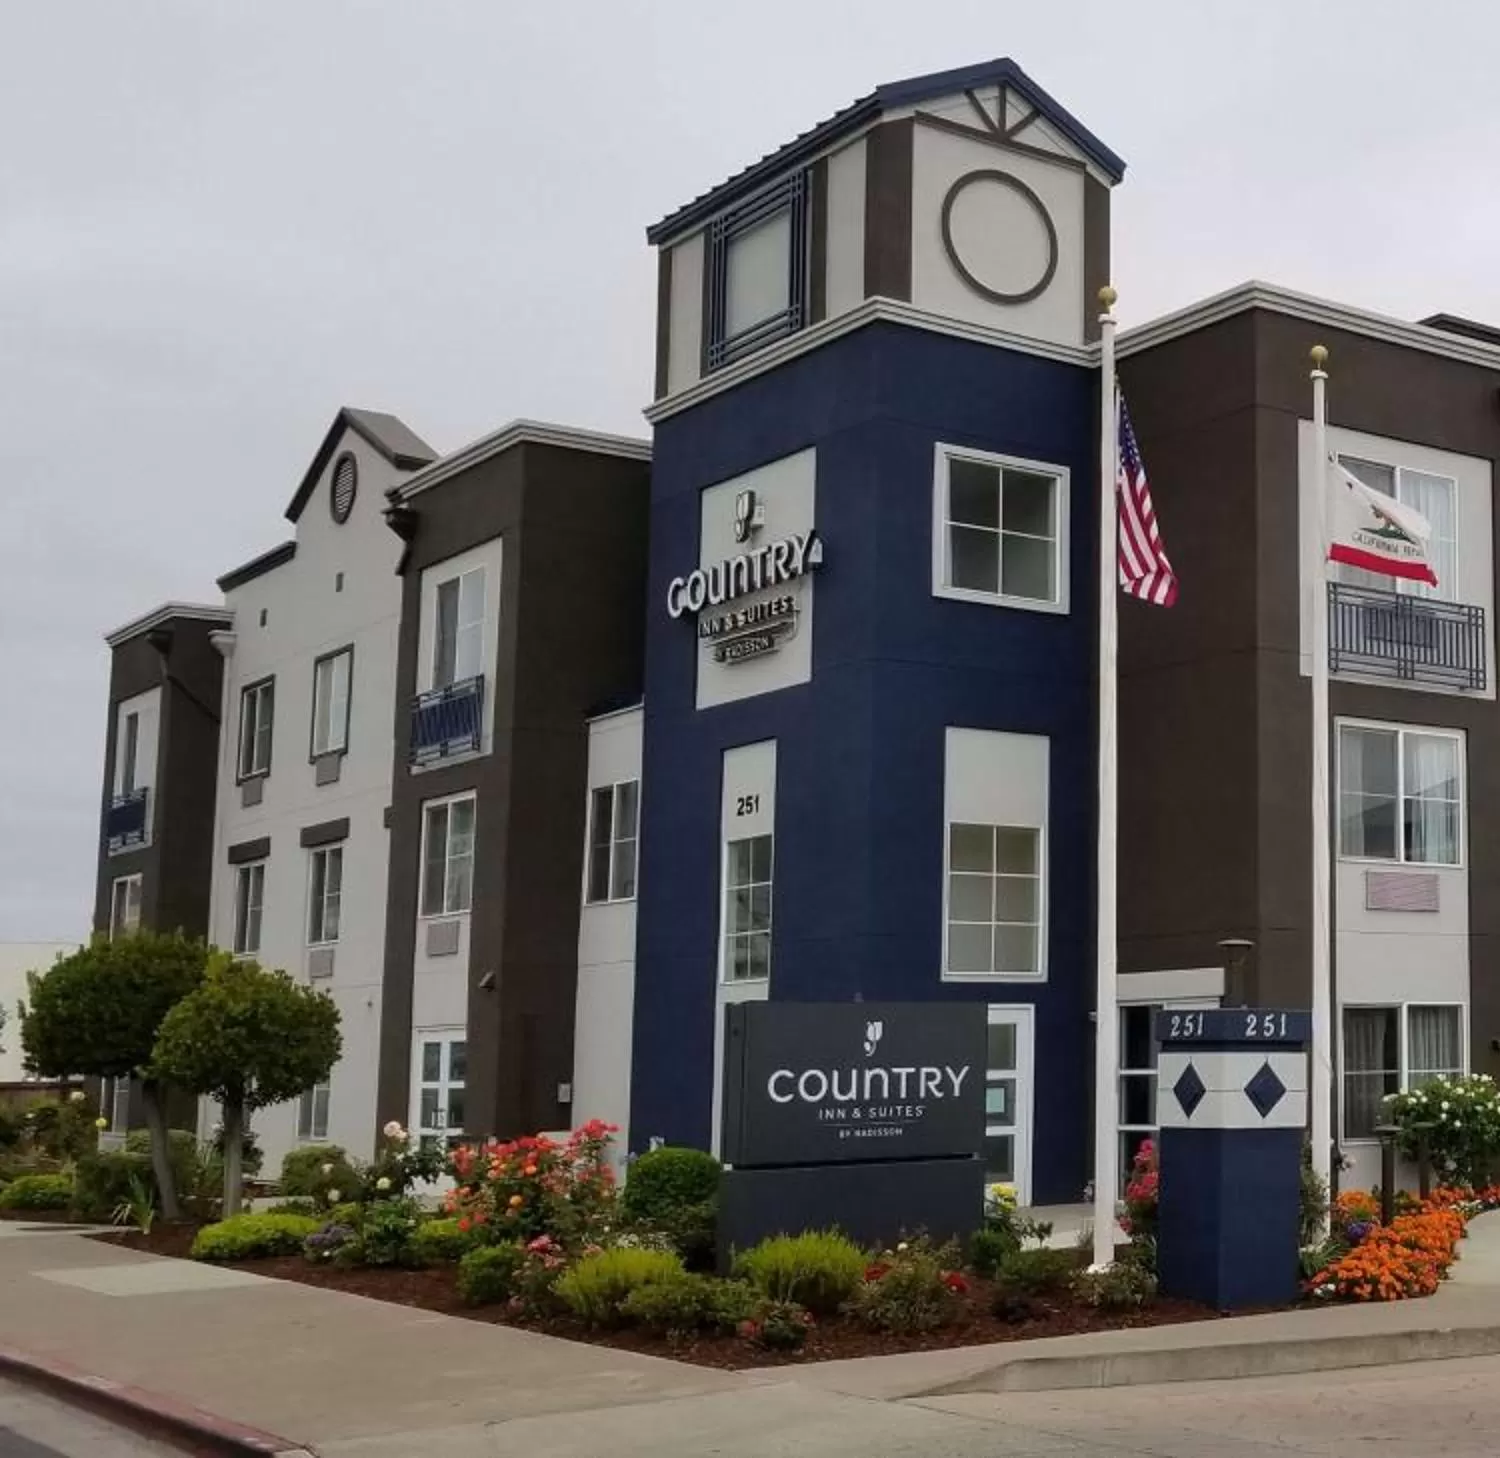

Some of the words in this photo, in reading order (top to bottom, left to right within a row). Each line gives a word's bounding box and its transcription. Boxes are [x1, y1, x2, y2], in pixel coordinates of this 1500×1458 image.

[667, 530, 816, 618] COUNTRY
[736, 595, 792, 628] SUITES
[736, 795, 760, 817] 251
[1170, 1013, 1203, 1037] 251
[1245, 1013, 1287, 1037] 251
[767, 1065, 970, 1103] COUNTRY
[819, 1107, 847, 1120] INN
[852, 1107, 861, 1119] &
[868, 1105, 926, 1119] SUITES
